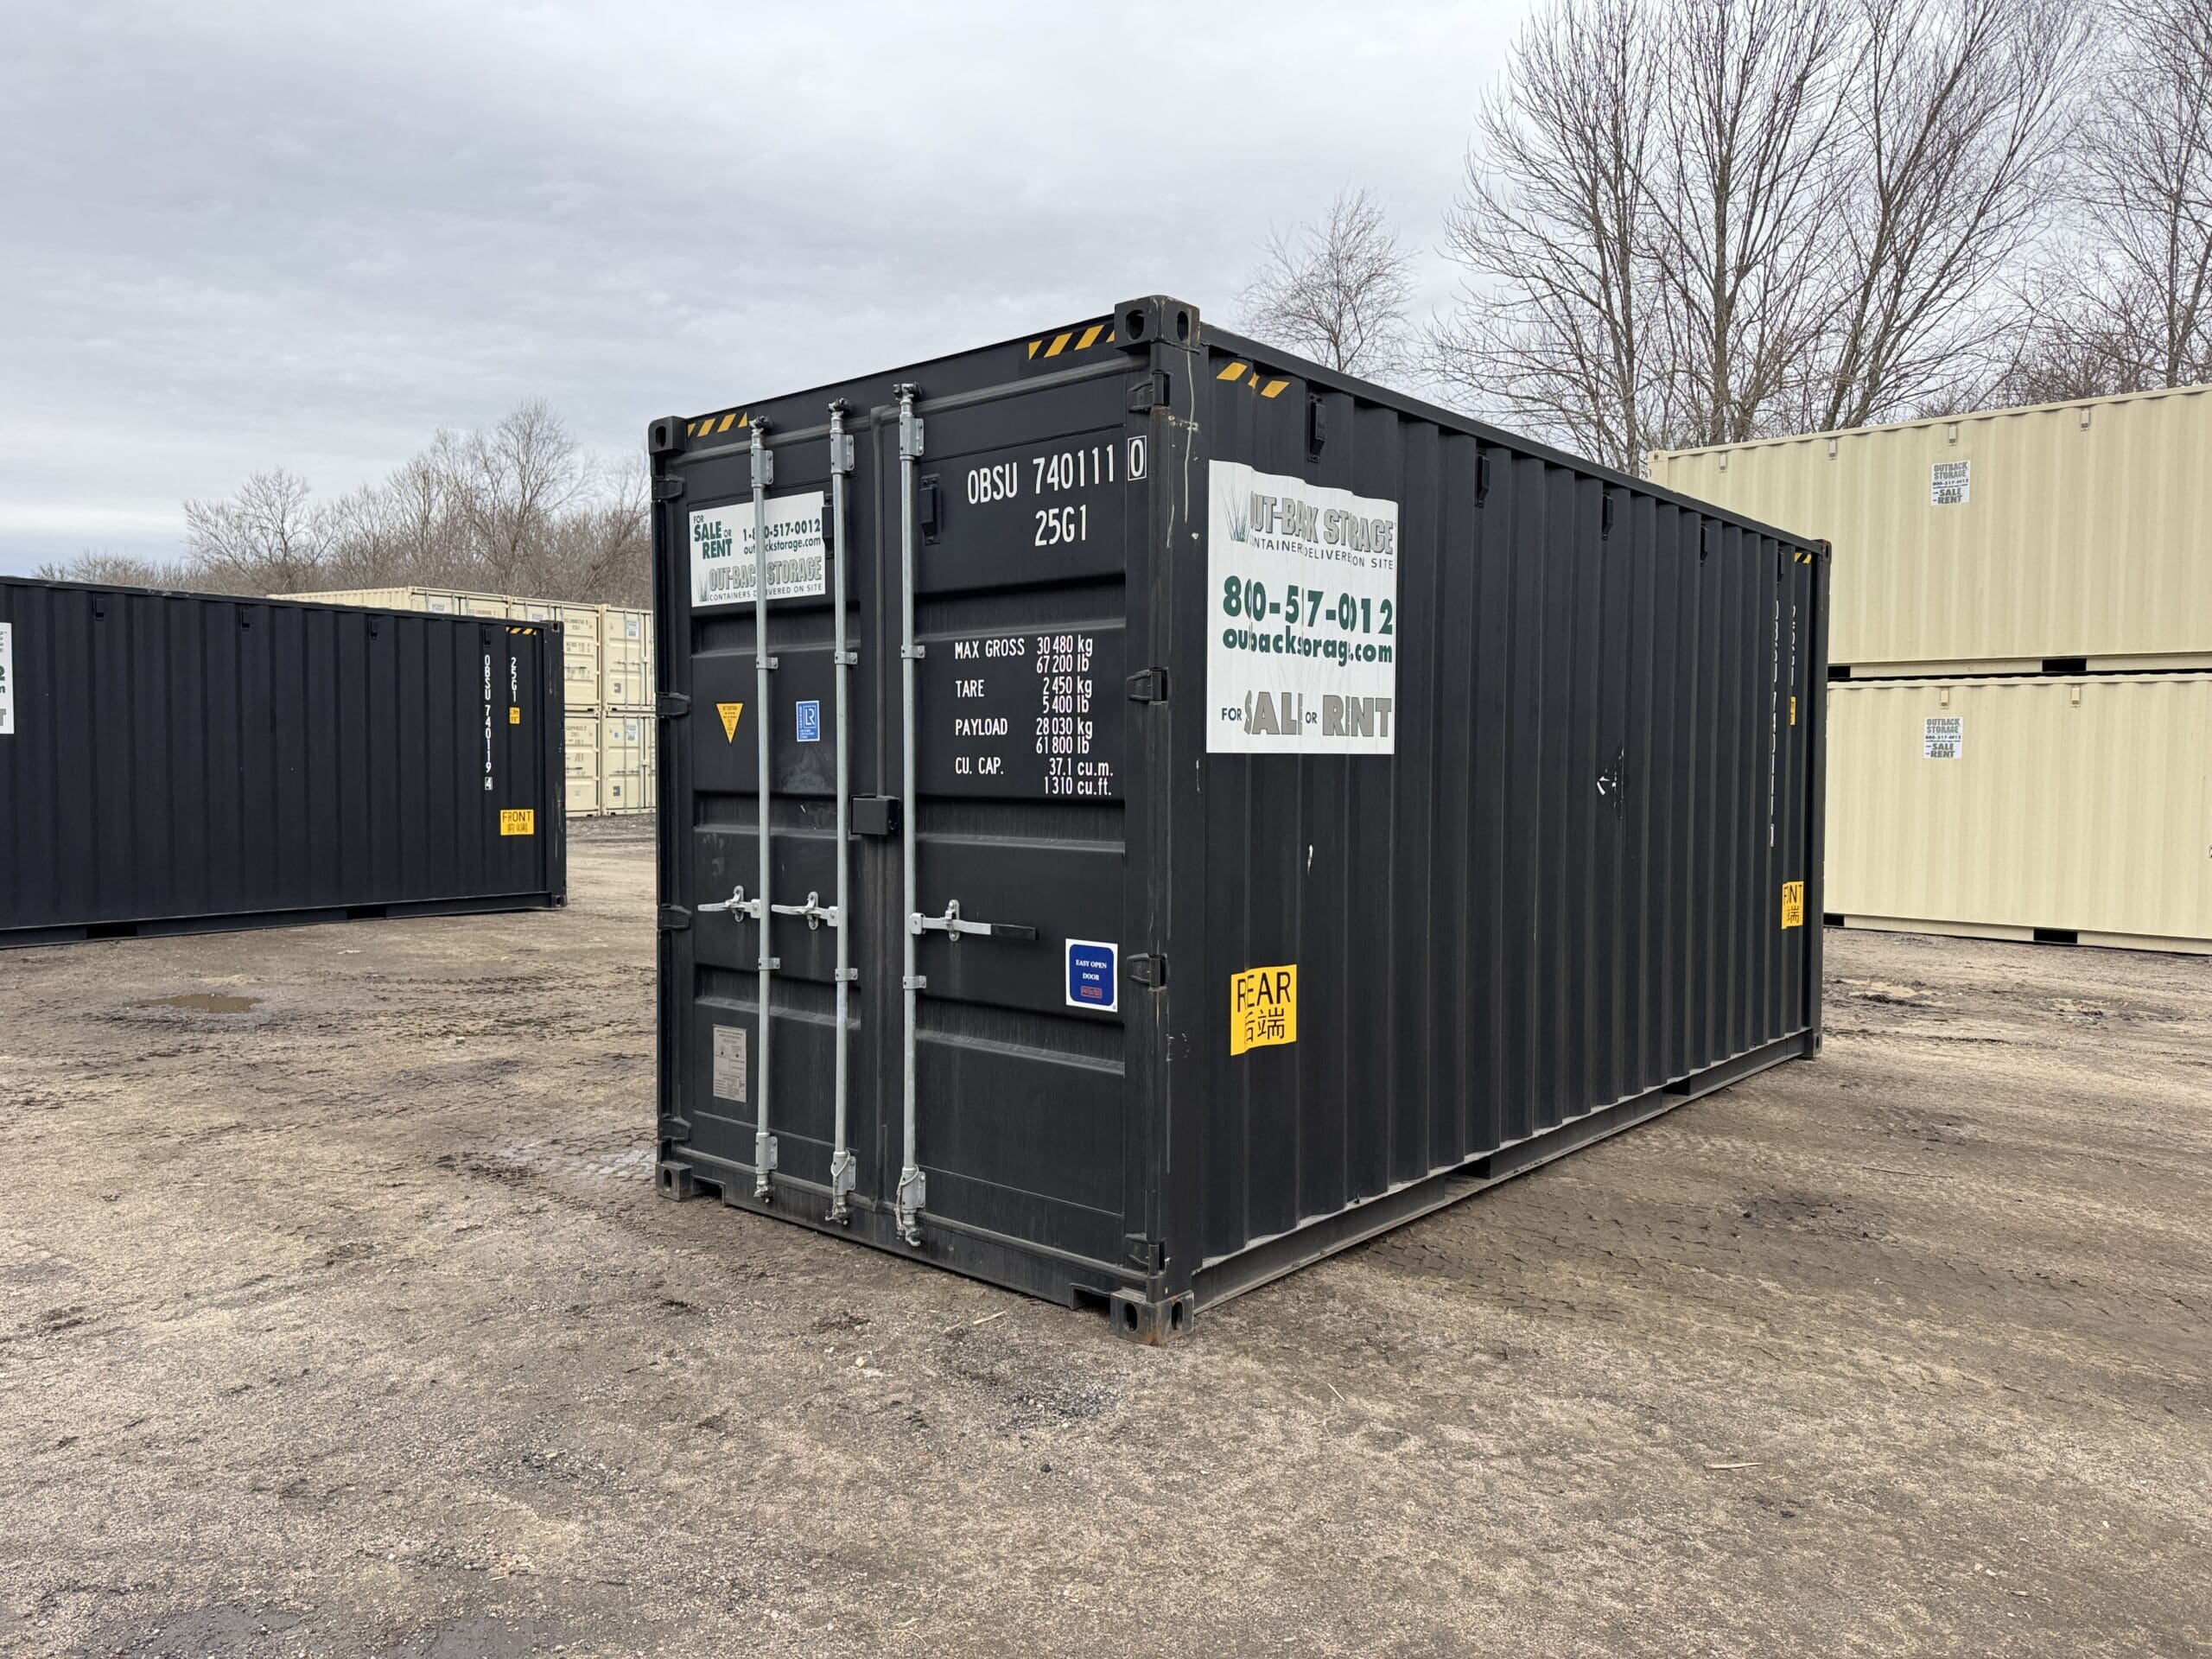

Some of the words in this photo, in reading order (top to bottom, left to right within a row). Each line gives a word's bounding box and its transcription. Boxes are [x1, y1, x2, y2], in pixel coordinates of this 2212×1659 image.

[967, 461, 1018, 505] OBSU
[1033, 444, 1114, 494] 740111
[1934, 461, 1967, 472] OUTBACK
[1934, 470, 1967, 480] STORAGE
[693, 515, 704, 524] FOR
[1034, 504, 1086, 546] 25G1
[694, 520, 722, 542] SALE
[723, 529, 732, 537] OR
[702, 538, 733, 560] RENT
[744, 537, 821, 555] outckstorage.com
[1352, 556, 1364, 567] ON
[1371, 558, 1393, 569] SITE
[709, 563, 757, 592] OUT-BAC
[766, 556, 822, 586] STORAGE
[709, 591, 751, 601] CONTAINERS
[807, 583, 823, 592] SITE
[955, 640, 979, 659] MAX
[985, 638, 1025, 658] GROSS
[1077, 634, 1093, 658] kg
[1077, 654, 1090, 672] lb
[955, 679, 985, 697] TARE
[1077, 676, 1093, 698] kg
[1077, 696, 1090, 713] lb
[1221, 708, 1242, 721] FOR
[1306, 711, 1318, 723] OR
[955, 718, 1008, 735] PAYLOAD
[1077, 717, 1093, 740] kg
[1077, 736, 1090, 754] lb
[955, 757, 973, 774] CU.
[978, 757, 1004, 775] CAP.
[1049, 758, 1071, 776] 37.1
[1077, 761, 1114, 776] cu.m.
[1077, 778, 1112, 796] cu.ft.
[502, 810, 532, 823] FRONT
[1075, 959, 1090, 968] EASY
[1083, 972, 1100, 981] DOOR
